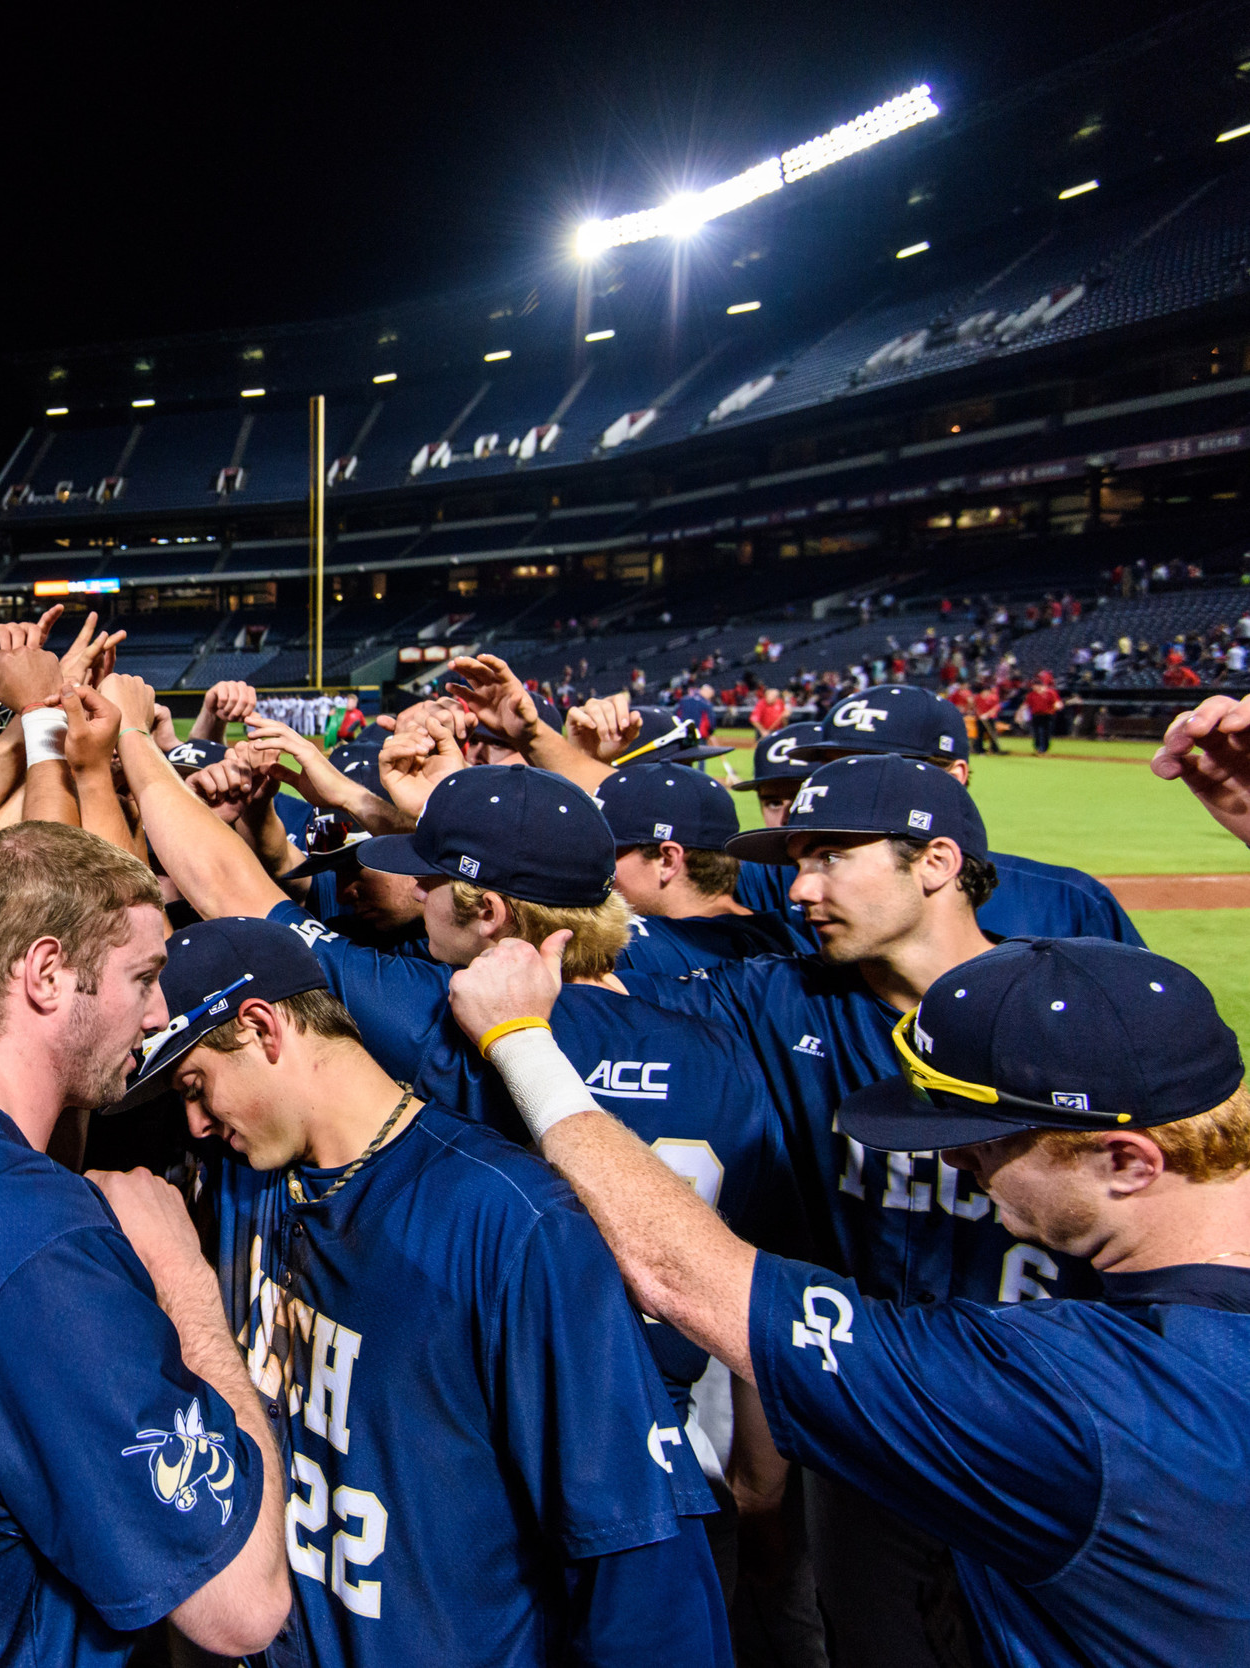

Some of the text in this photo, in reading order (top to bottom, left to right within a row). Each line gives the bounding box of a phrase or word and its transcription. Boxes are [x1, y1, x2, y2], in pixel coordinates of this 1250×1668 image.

[833, 700, 888, 732] GT
[168, 742, 207, 765] GT
[584, 1059, 672, 1098] ACC
[285, 1451, 389, 1619] 22
